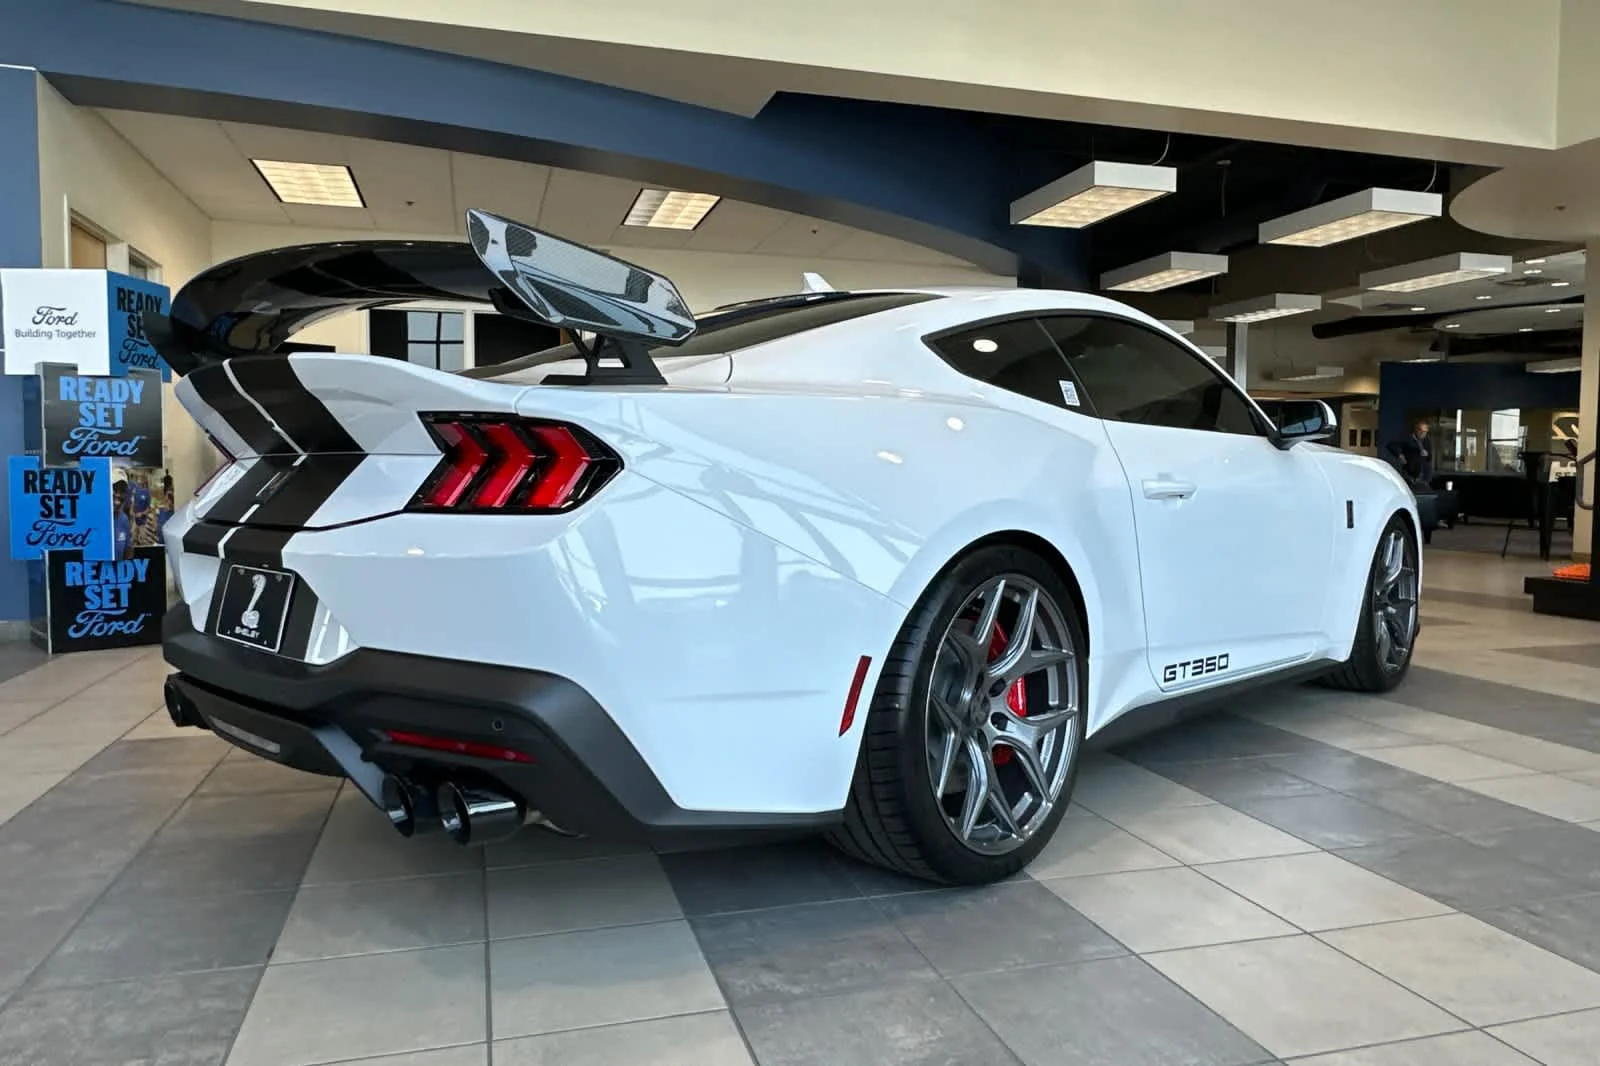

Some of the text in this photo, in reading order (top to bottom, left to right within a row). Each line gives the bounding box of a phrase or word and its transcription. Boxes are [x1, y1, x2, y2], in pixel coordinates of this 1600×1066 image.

[117, 287, 162, 314] READY
[32, 305, 79, 326] Ford
[127, 312, 145, 339] SE
[15, 329, 96, 339] Building Together
[119, 338, 158, 369] Ford
[59, 375, 145, 405] READY
[79, 402, 127, 428] SET
[62, 426, 141, 456] Ford
[24, 470, 96, 495] READY
[40, 495, 79, 519] SET
[26, 519, 92, 547] Ford
[65, 558, 150, 586] READY
[84, 583, 132, 610] SET
[68, 608, 145, 639] Ford
[1163, 653, 1229, 683] GT350
